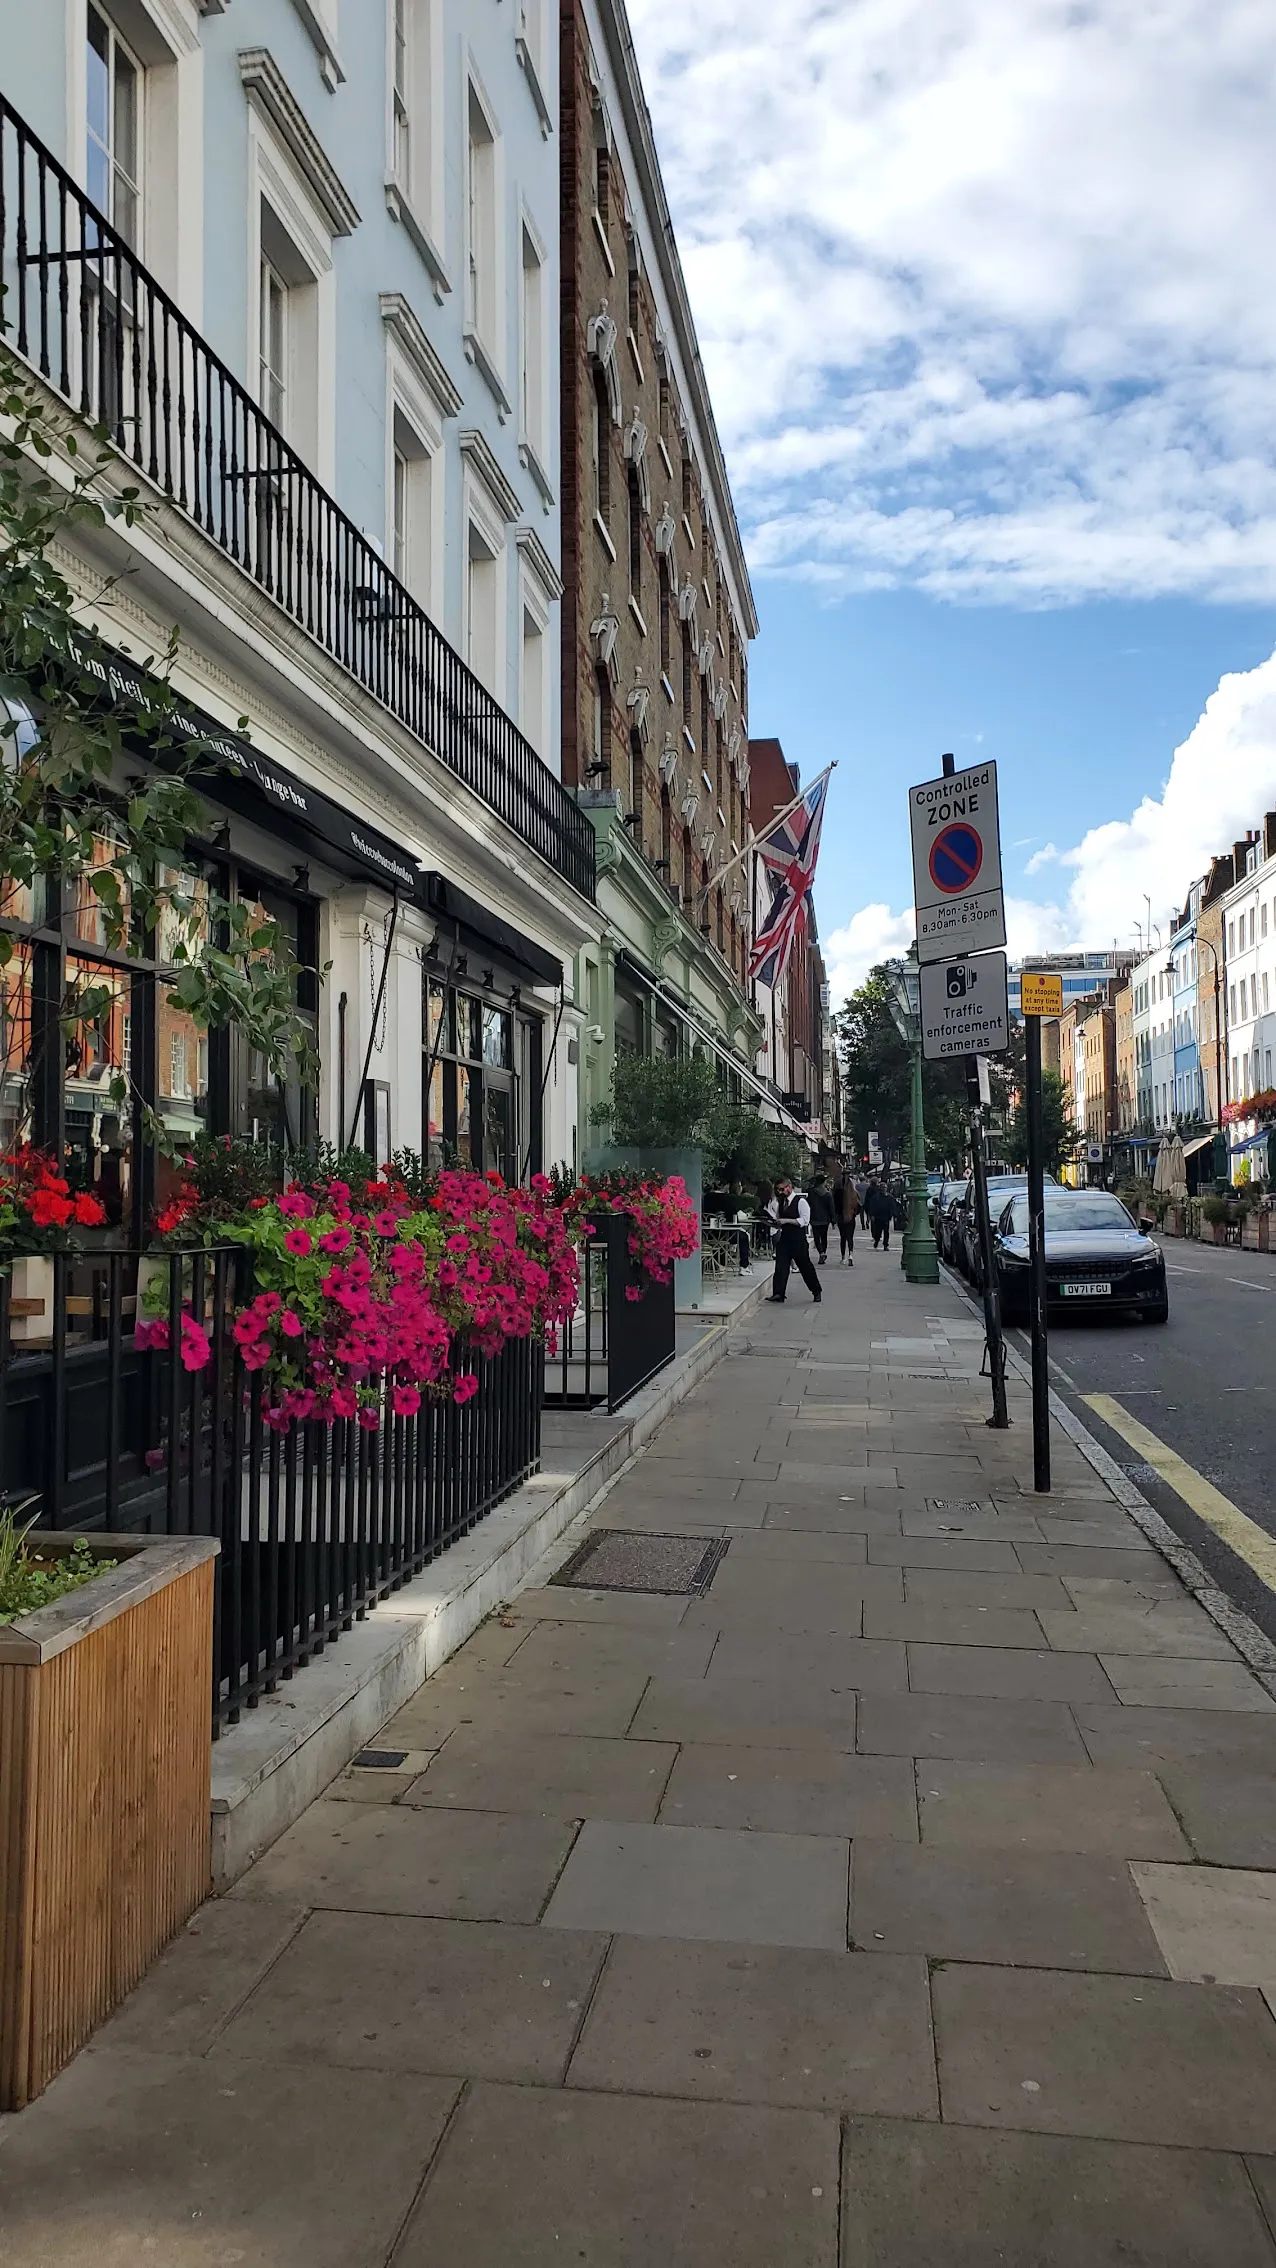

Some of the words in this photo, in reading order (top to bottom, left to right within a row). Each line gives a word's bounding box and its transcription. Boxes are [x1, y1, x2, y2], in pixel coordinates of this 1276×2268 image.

[109, 666, 152, 713] Sicily
[201, 730, 249, 769] cnteen
[290, 785, 308, 811] bar
[915, 769, 990, 806] Controlled
[927, 793, 980, 826] ZONE
[1034, 988, 1060, 996] stopping
[943, 1003, 983, 1019] Traffic
[926, 1016, 1003, 1038] enforcement
[939, 1037, 990, 1053] cameras
